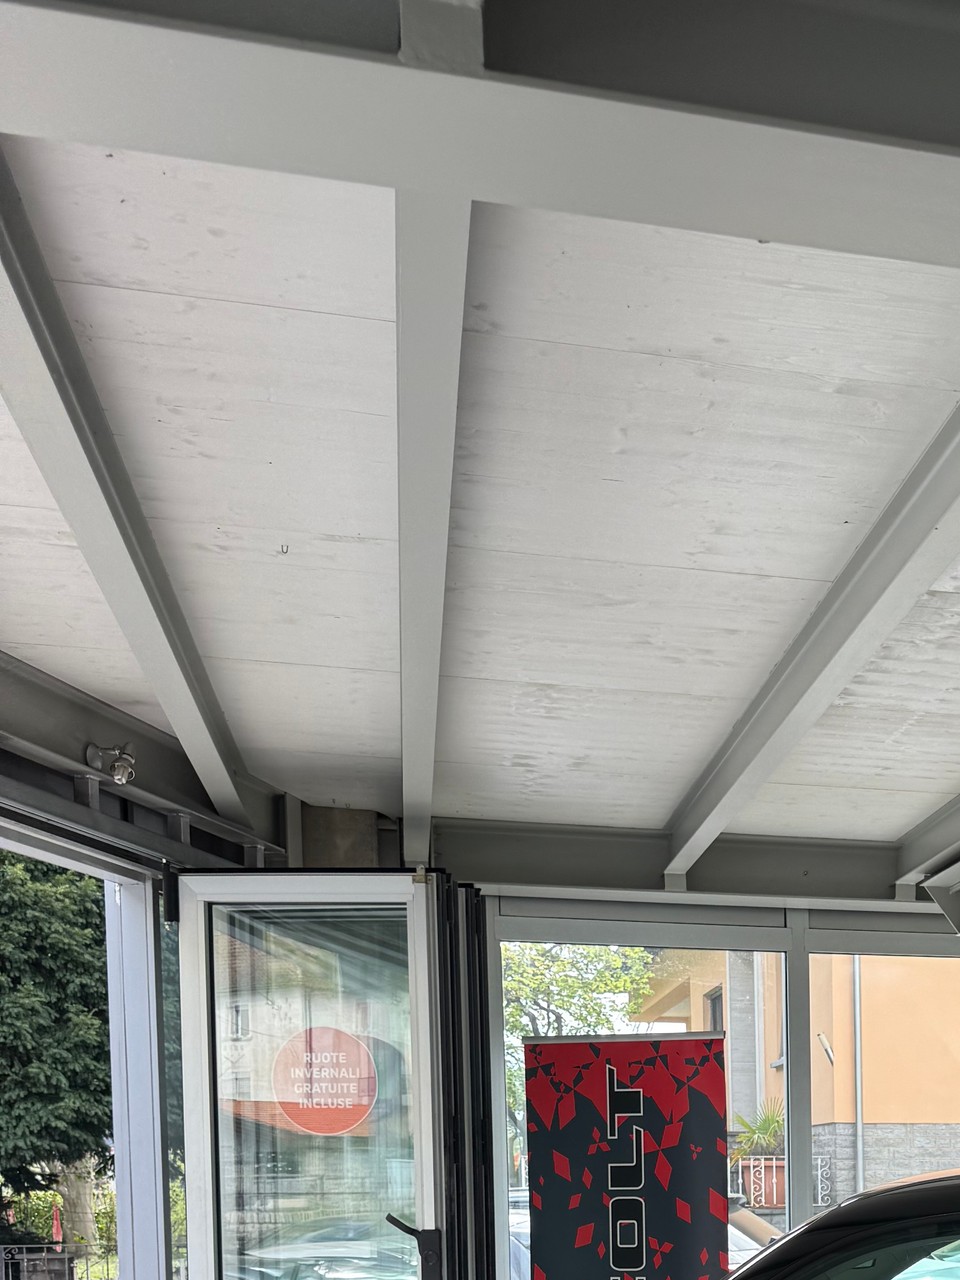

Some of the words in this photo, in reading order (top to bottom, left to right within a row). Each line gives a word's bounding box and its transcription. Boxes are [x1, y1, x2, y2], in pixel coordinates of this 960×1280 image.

[303, 1052, 347, 1064] RUOTE
[290, 1067, 360, 1079] INVERNALI
[294, 1082, 358, 1094] GRATUITE
[299, 1097, 353, 1109] INCLUSE
